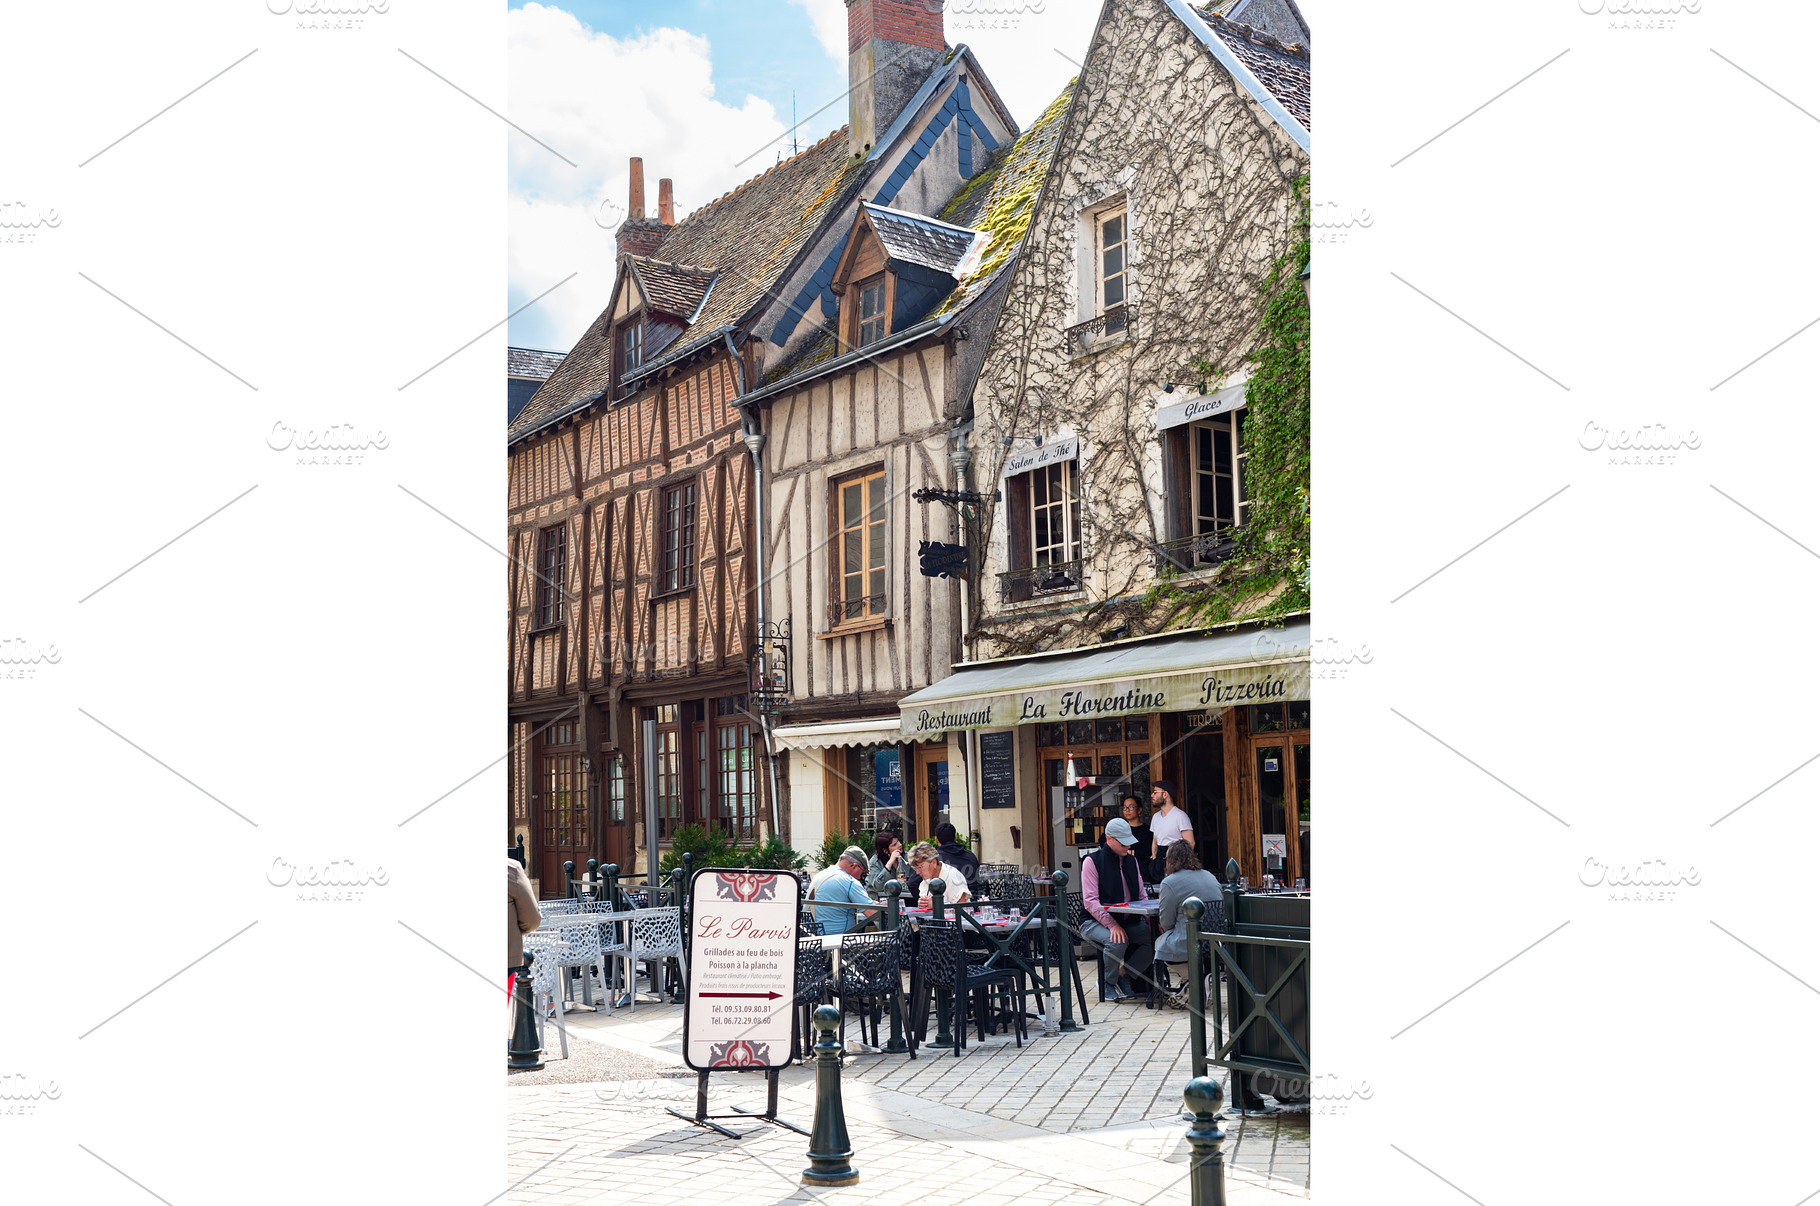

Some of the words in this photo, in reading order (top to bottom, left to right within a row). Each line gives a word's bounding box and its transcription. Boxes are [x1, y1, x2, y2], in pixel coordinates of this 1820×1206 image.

[1185, 400, 1221, 420] Glaces
[1009, 457, 1033, 470] Salon
[1039, 451, 1048, 462] de
[1053, 443, 1070, 458] Thé
[916, 705, 992, 731] Restaurant
[1020, 697, 1047, 720] La
[1059, 688, 1166, 716] Florentine
[1200, 674, 1286, 704] Pizzeria
[698, 915, 722, 938] Le
[726, 917, 791, 939] Parvis
[704, 948, 734, 956] Grillades
[746, 948, 758, 956] feu
[759, 949, 768, 957] de
[770, 949, 783, 957] bois
[709, 961, 735, 969] Poisson
[736, 961, 740, 969] à
[742, 961, 749, 969] la
[751, 961, 778, 971] plancha
[712, 1005, 723, 1013] Tél.
